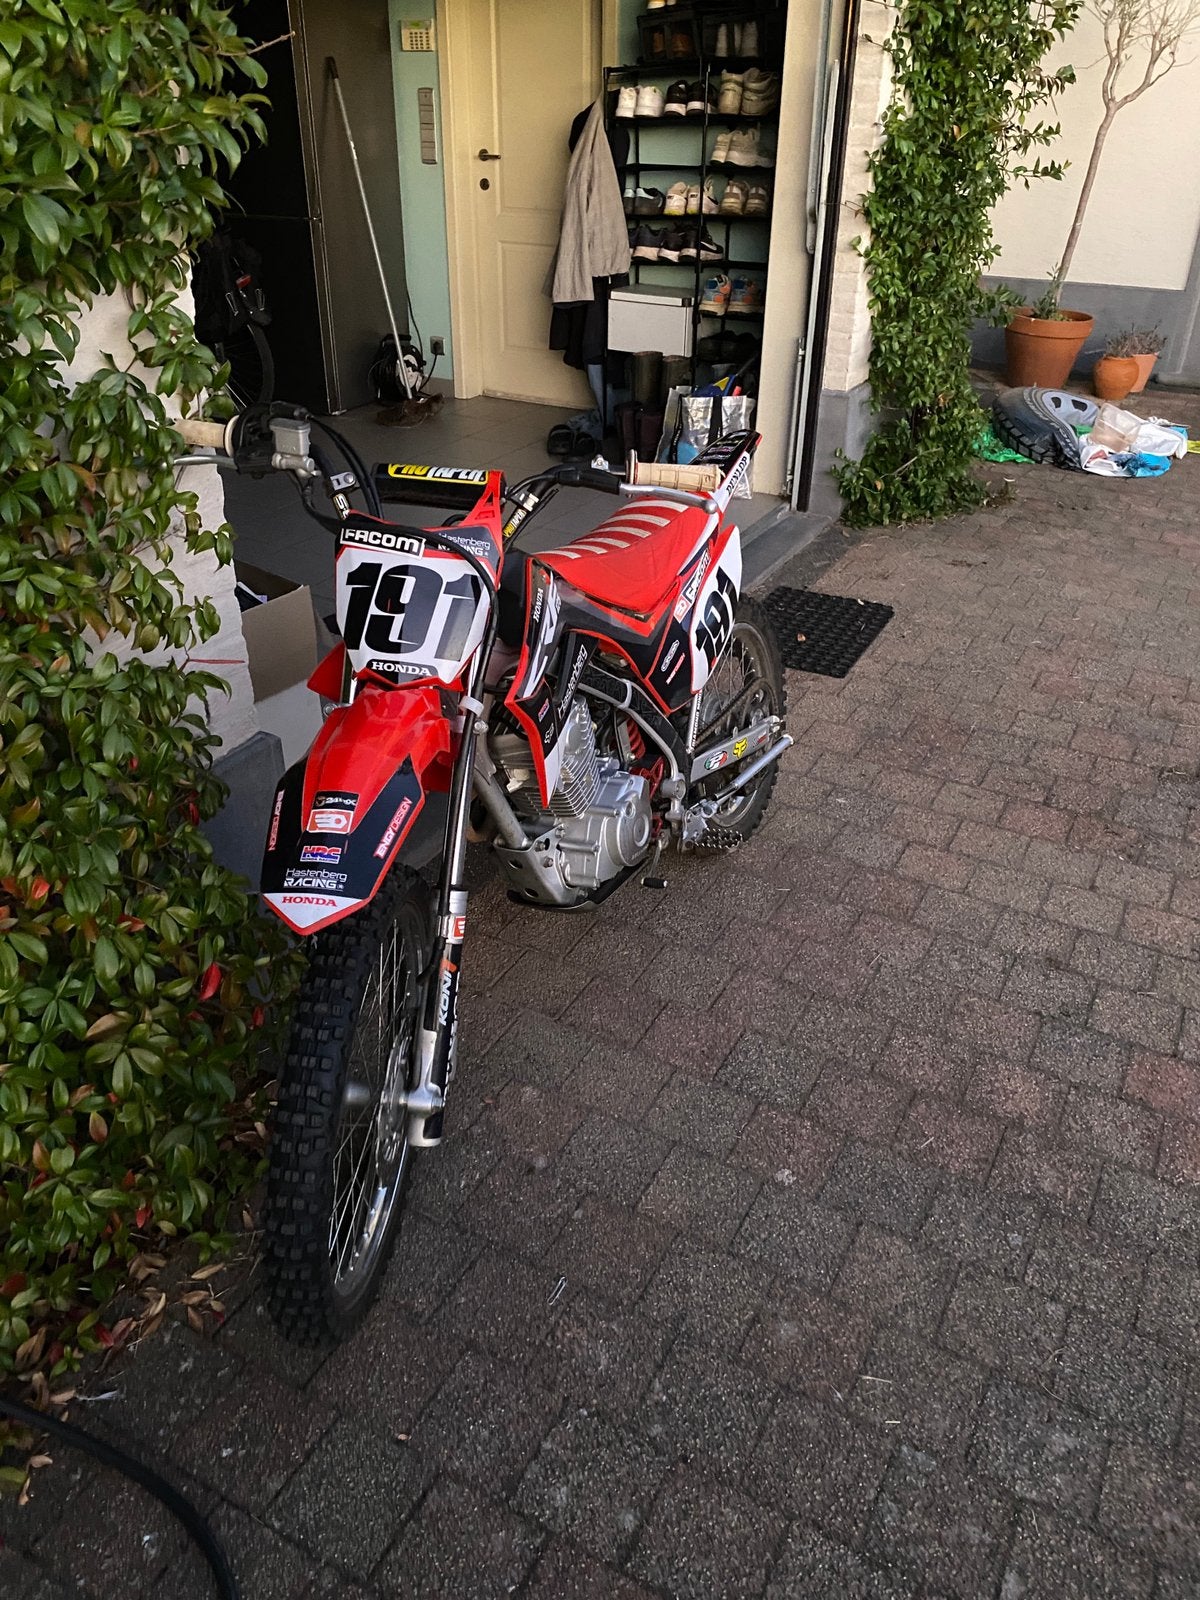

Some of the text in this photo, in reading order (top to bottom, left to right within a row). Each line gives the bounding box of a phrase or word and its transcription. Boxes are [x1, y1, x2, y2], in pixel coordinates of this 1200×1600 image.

[344, 562, 482, 662] 191
[533, 588, 544, 623] HONDA
[371, 661, 433, 676] HONDA
[301, 846, 342, 860] HRC
[286, 868, 347, 882] Hastenberg
[284, 878, 337, 890] RACING
[282, 896, 337, 907] HONDA
